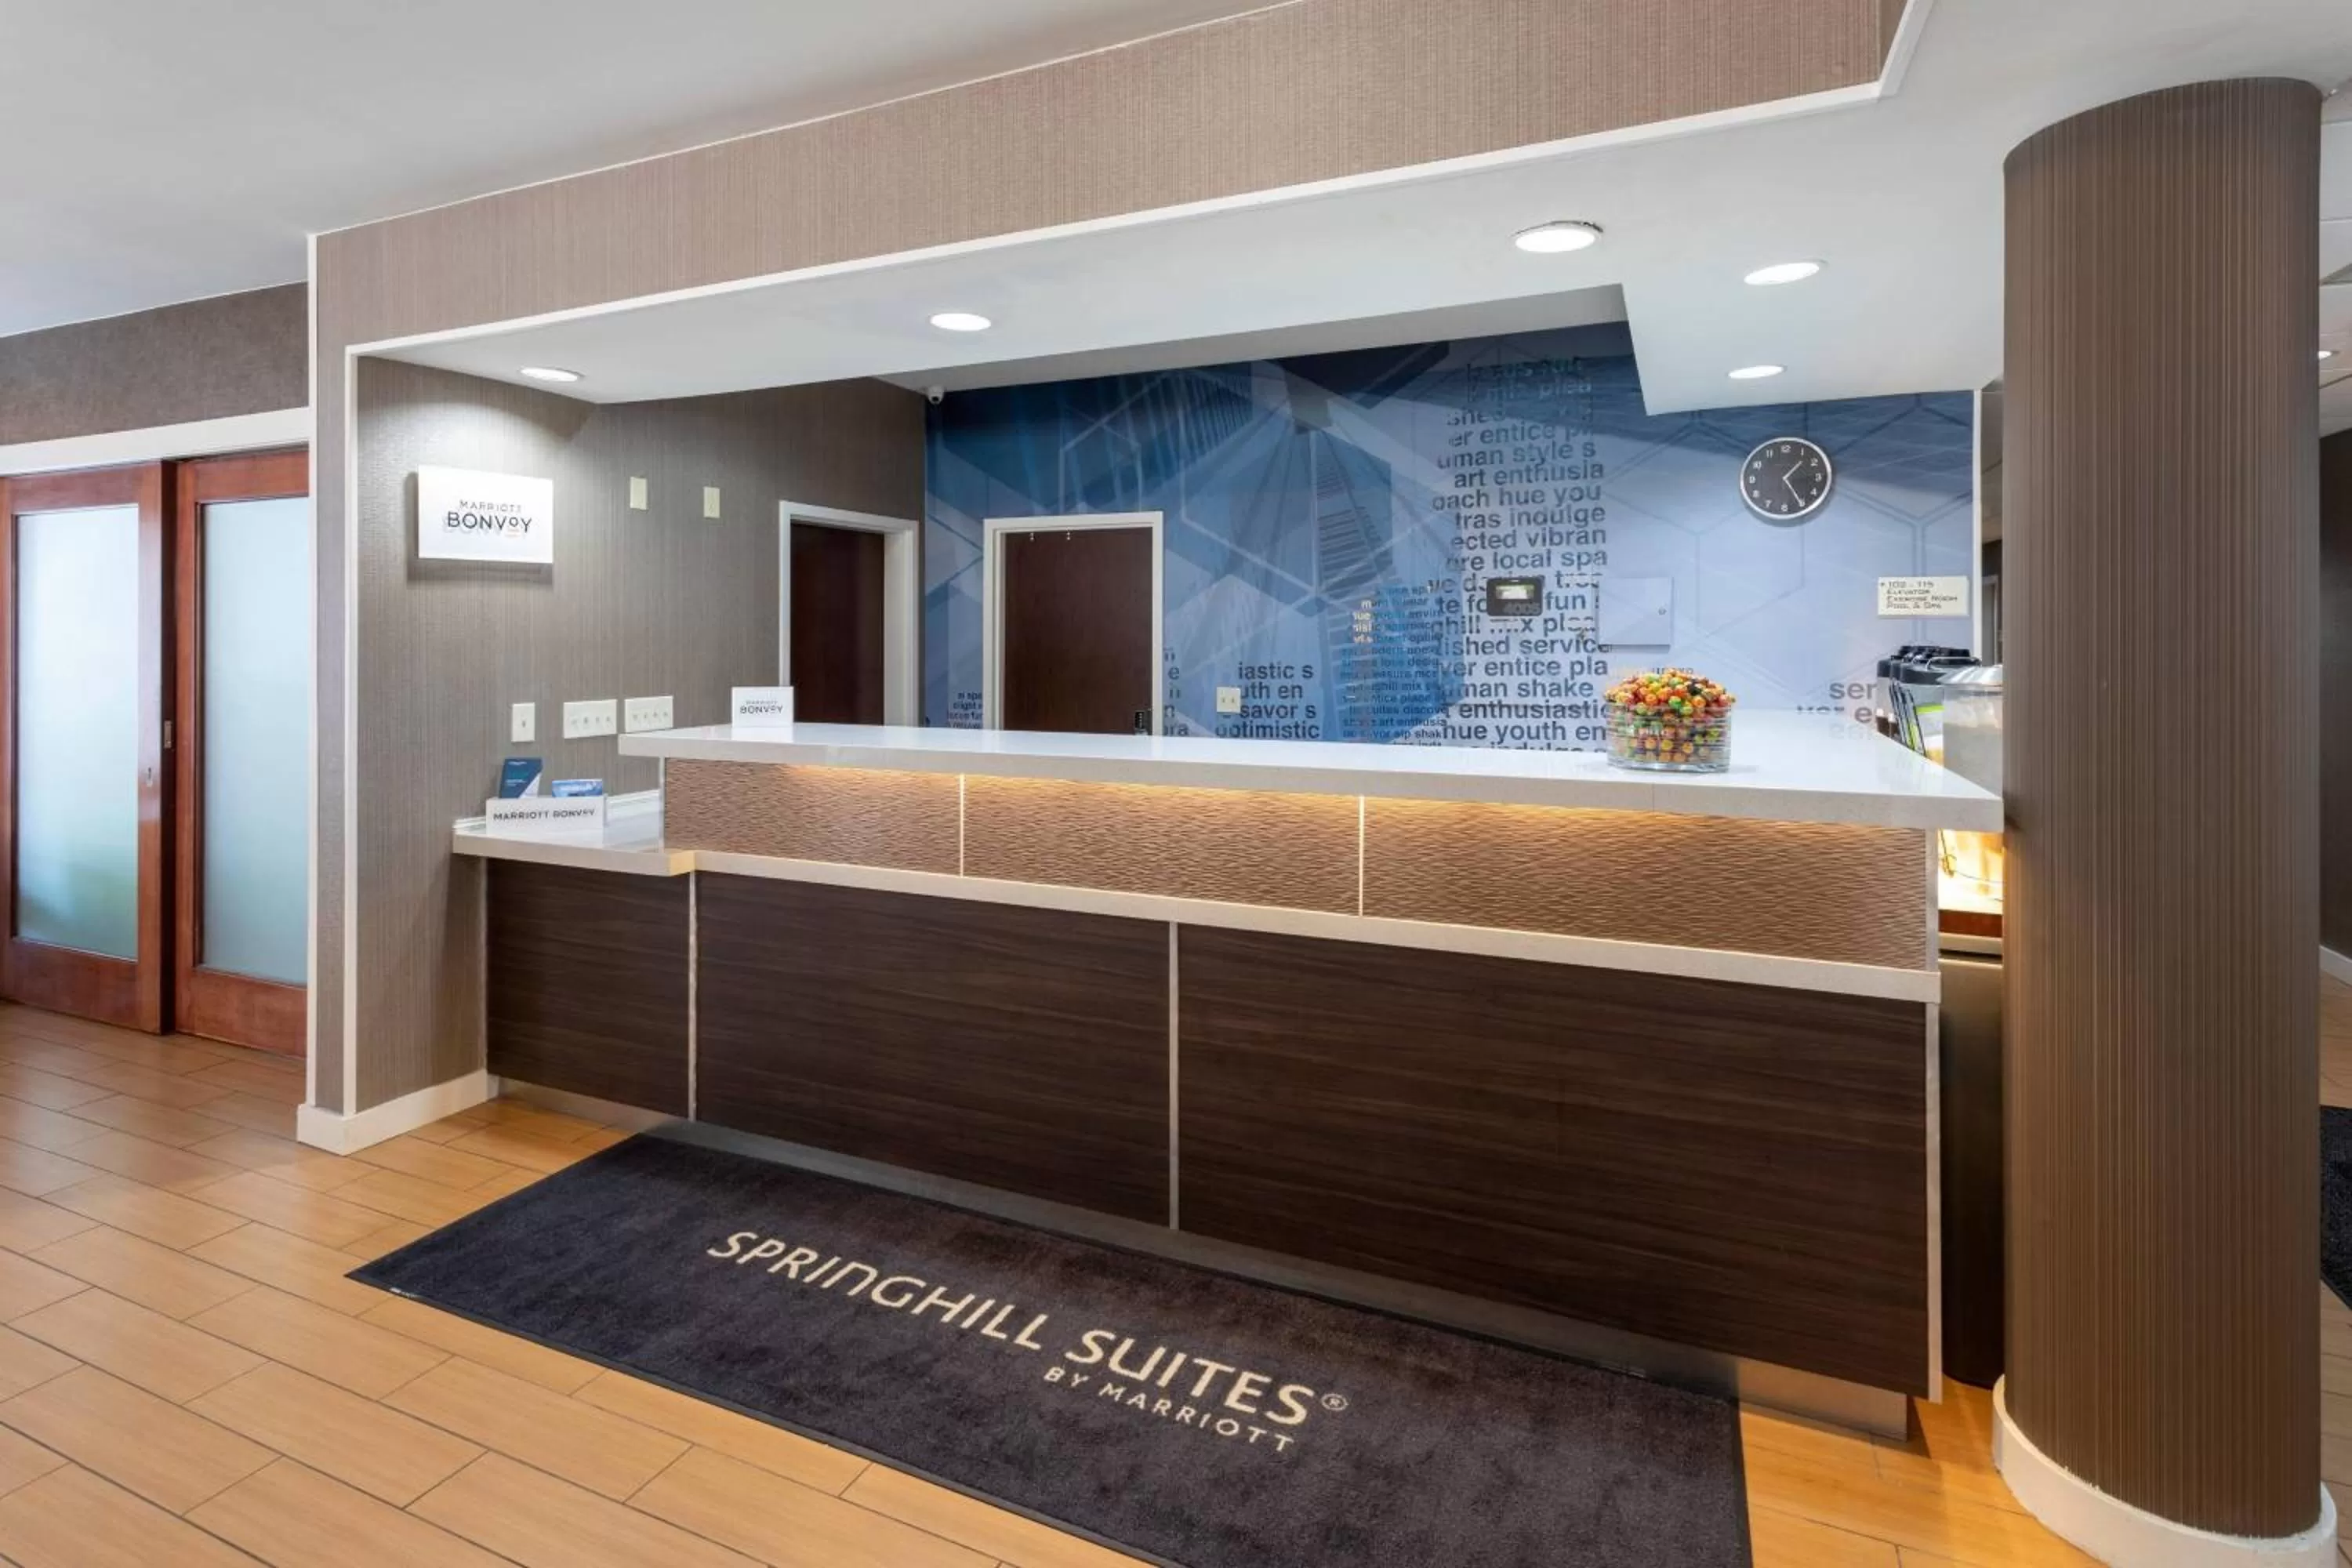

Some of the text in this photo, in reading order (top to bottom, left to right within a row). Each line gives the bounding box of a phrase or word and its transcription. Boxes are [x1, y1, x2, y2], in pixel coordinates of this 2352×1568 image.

[1454, 460, 1605, 488] art enthusia
[459, 499, 521, 514] MARRIOTT
[1499, 486, 1545, 506] hue
[1554, 485, 1601, 508] you
[448, 511, 532, 533] BONVOY
[1509, 506, 1606, 529] indulge
[1527, 526, 1606, 548] vibran
[1493, 549, 1552, 571] local
[1561, 551, 1607, 572] spa
[1545, 592, 1587, 611] fun
[1239, 661, 1294, 680] iastic
[1484, 657, 1562, 677] entice
[1570, 655, 1607, 681] pla
[1278, 685, 1303, 699] en
[1517, 678, 1594, 698] shake
[1240, 704, 1299, 719] savor
[1495, 720, 1566, 743] youth
[1575, 725, 1606, 741] en
[493, 811, 549, 821] MARRIOTT
[706, 1230, 1050, 1351] SPRINGHILL
[1043, 1367, 1295, 1453] BY MARRIOTT
